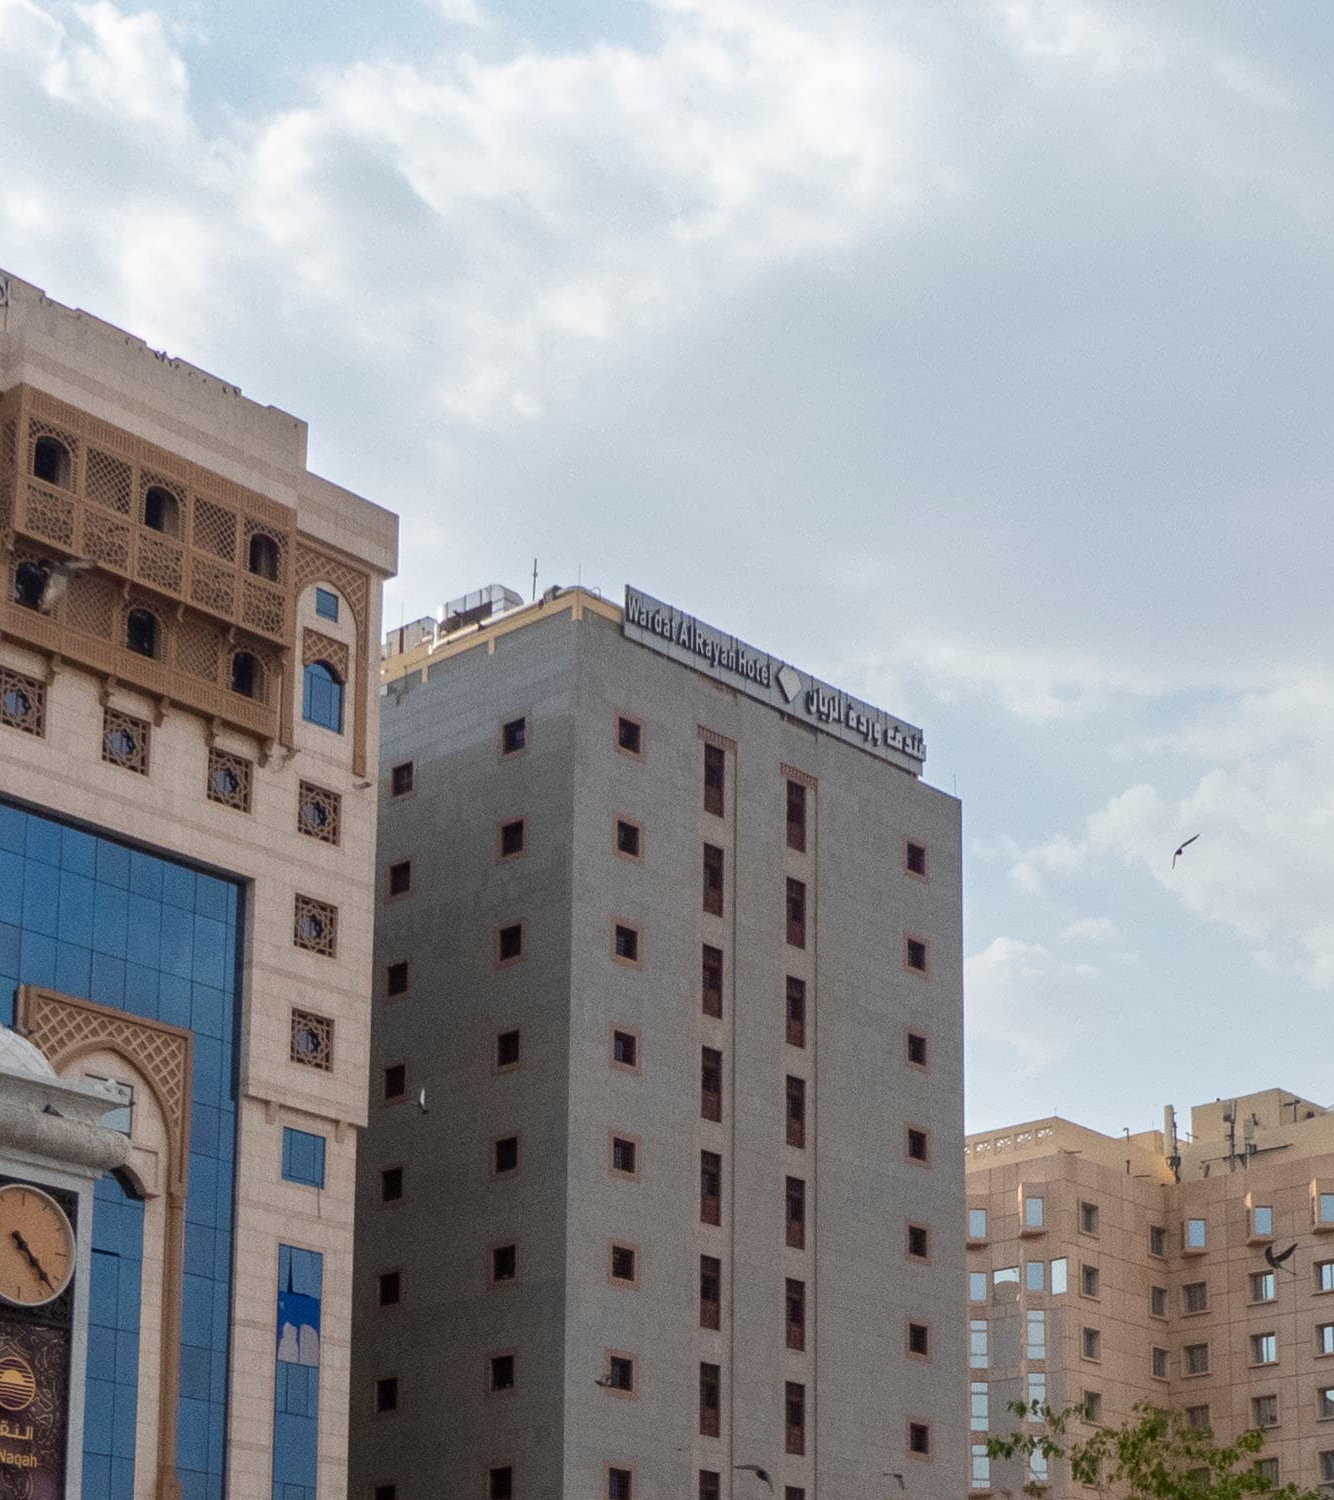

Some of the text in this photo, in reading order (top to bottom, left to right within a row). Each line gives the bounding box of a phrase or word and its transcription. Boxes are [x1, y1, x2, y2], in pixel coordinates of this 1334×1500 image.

[628, 595, 676, 642] Wardat
[739, 650, 772, 688] Hotel
[807, 687, 844, 723] الريان
[848, 704, 882, 746] وردة
